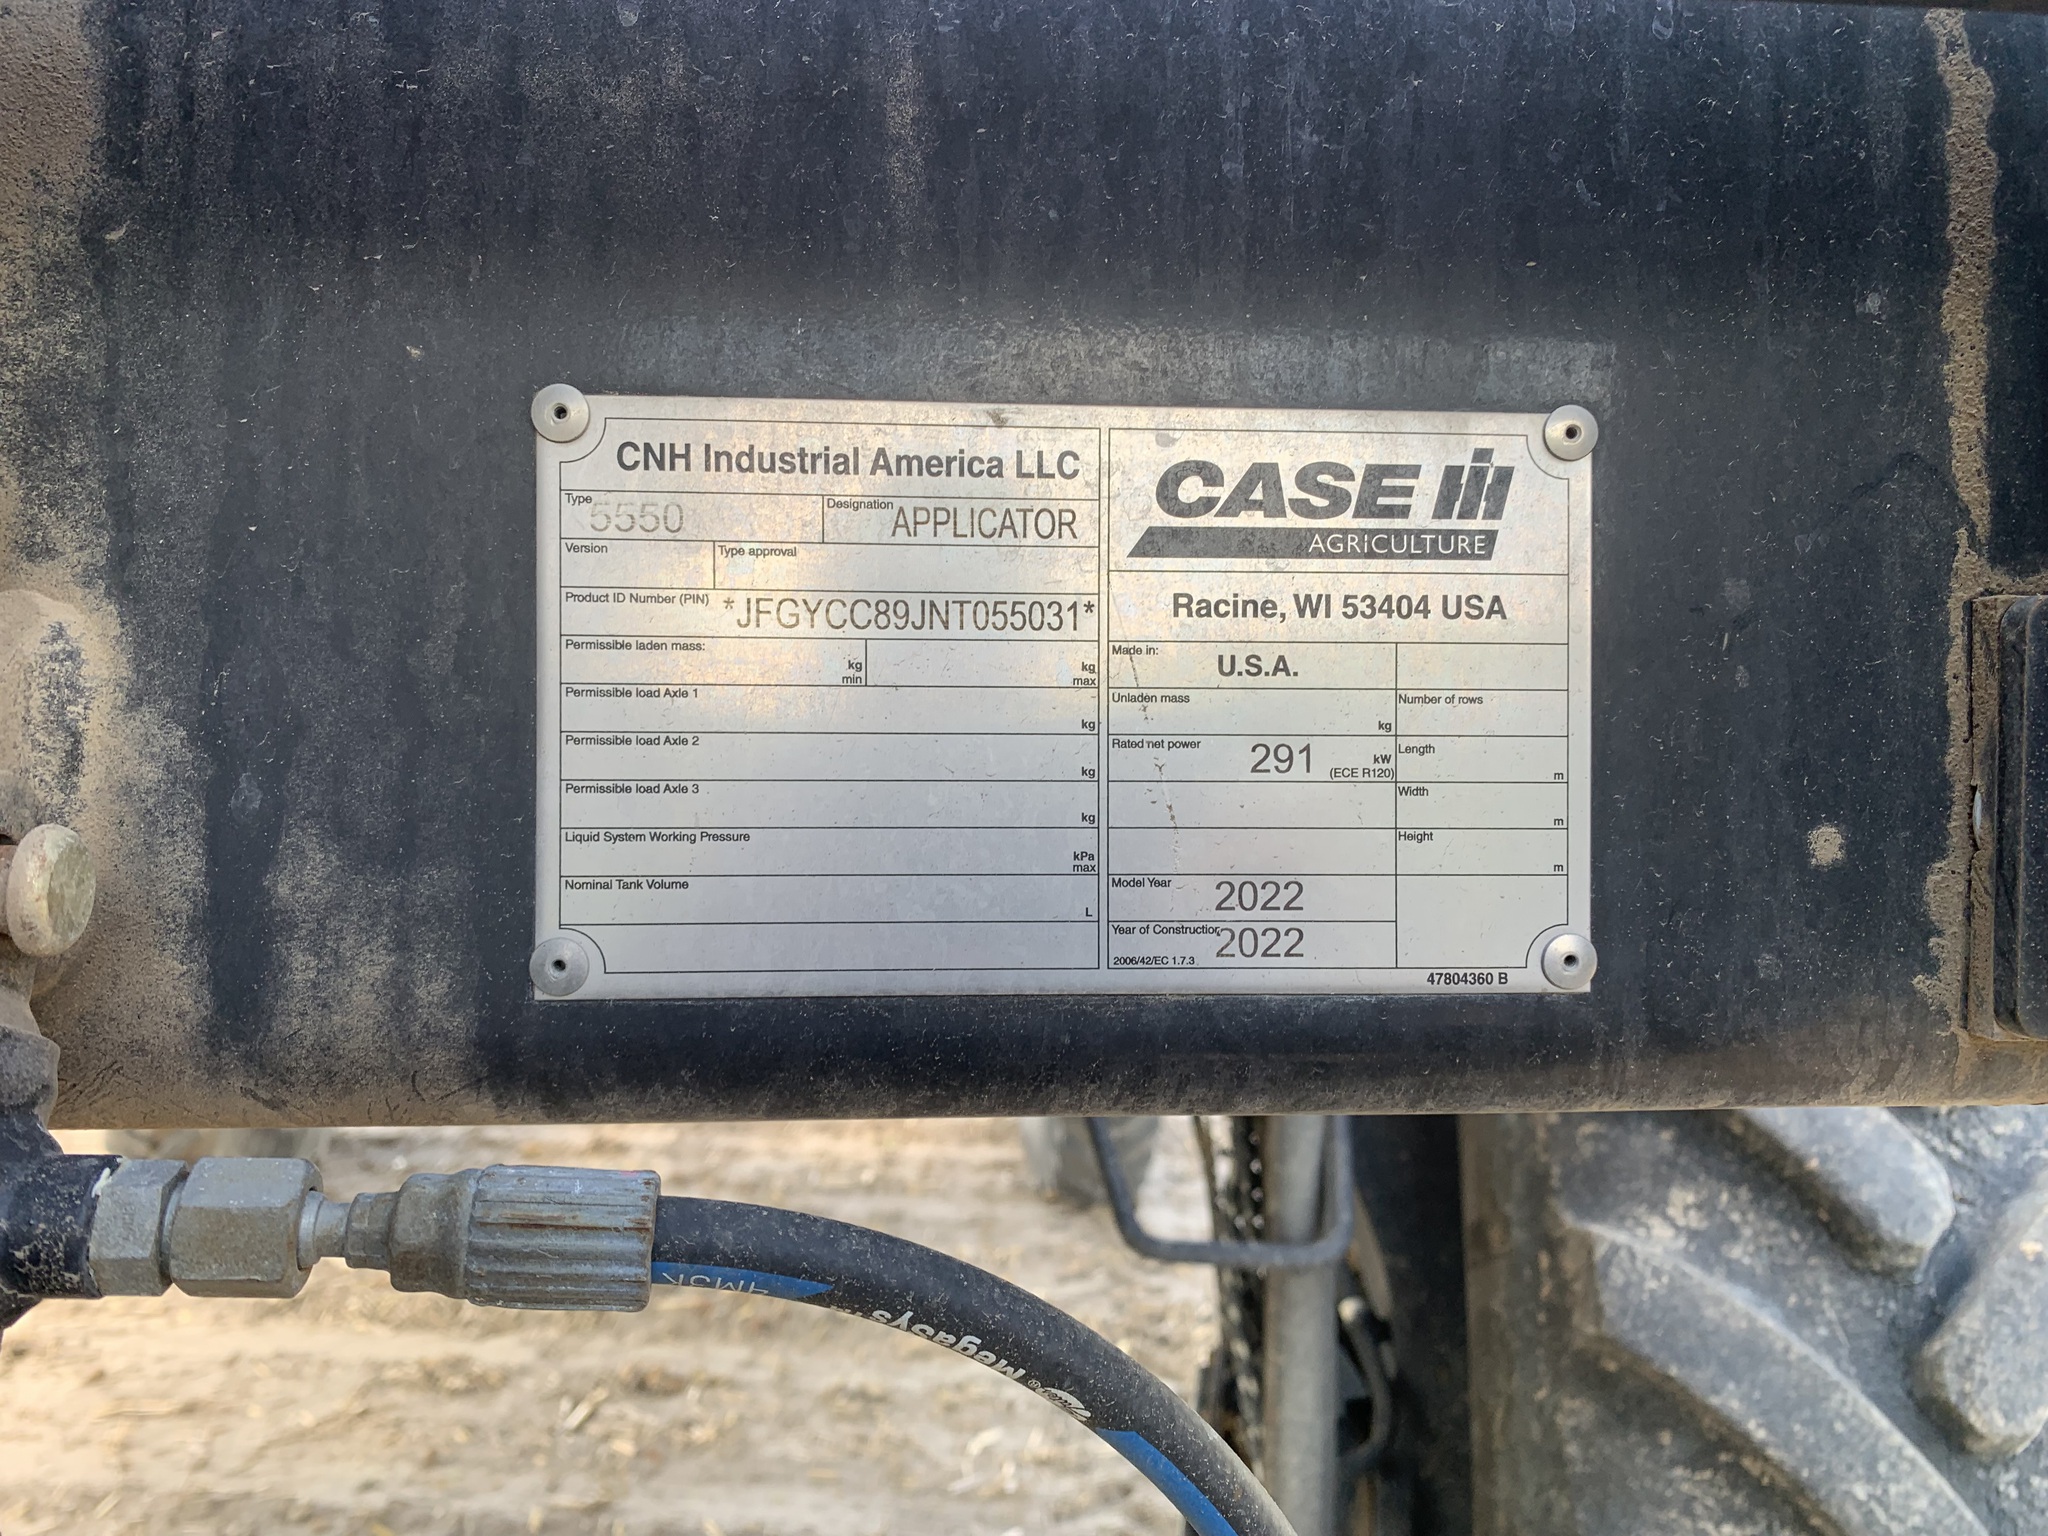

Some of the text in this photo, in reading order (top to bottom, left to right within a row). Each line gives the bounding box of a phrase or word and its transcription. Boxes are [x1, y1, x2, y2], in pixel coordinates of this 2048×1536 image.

[616, 442, 1080, 480] CNH Industrial America LLC
[1155, 460, 1422, 520] CASE
[565, 493, 592, 506] Type
[827, 498, 894, 512] Designation
[590, 503, 685, 532] 5550
[891, 507, 1077, 539] APPLICATOR
[565, 543, 608, 554] Version
[1308, 534, 1486, 554] AGRICULTURE
[718, 546, 796, 559] Type approval
[565, 593, 709, 606] Product ID Number (PIN)
[1173, 594, 1507, 622] Racine, WI 53404 USA
[565, 640, 705, 652] Permissible laden mass:
[1112, 646, 1159, 655] Made in:
[848, 660, 862, 673] kg
[1081, 661, 1096, 675] kg
[1217, 655, 1299, 677] U.S.A.
[842, 675, 862, 684] min
[1072, 677, 1096, 686] max
[565, 687, 698, 698] Permissible load Axle 1
[1112, 694, 1190, 703] Unladen mass
[1400, 695, 1483, 704] Number of rows
[1081, 719, 1096, 732] kg
[1378, 721, 1392, 732] kg
[565, 735, 699, 746] Permissible load Axle 2
[1112, 739, 1201, 751] Rated net power
[1398, 744, 1435, 756] Length
[1250, 744, 1312, 773] 291
[1373, 754, 1392, 764] kW
[1081, 766, 1096, 779] kg
[1329, 767, 1394, 780] (ECE R120)
[1554, 772, 1563, 780] m
[565, 783, 699, 794] Permissible load Axle 3
[1398, 787, 1429, 797] Width
[1081, 812, 1096, 825] kg
[565, 831, 750, 845] Liquid System Working Pressure
[1398, 831, 1433, 843] Height
[1073, 851, 1095, 861] kPa
[1072, 863, 1096, 872] max
[1554, 864, 1563, 872] m
[565, 879, 689, 890] Nominal Tank Volume
[1112, 878, 1171, 888] Model Year
[1215, 881, 1304, 911] 2022
[1086, 907, 1092, 917] L
[1112, 925, 1135, 935] Year
[1139, 925, 1150, 935] of
[1216, 928, 1304, 958] 2022
[1113, 956, 1195, 966] 2006/42/EC 1.7.3
[1427, 972, 1508, 985] 47804360 B
